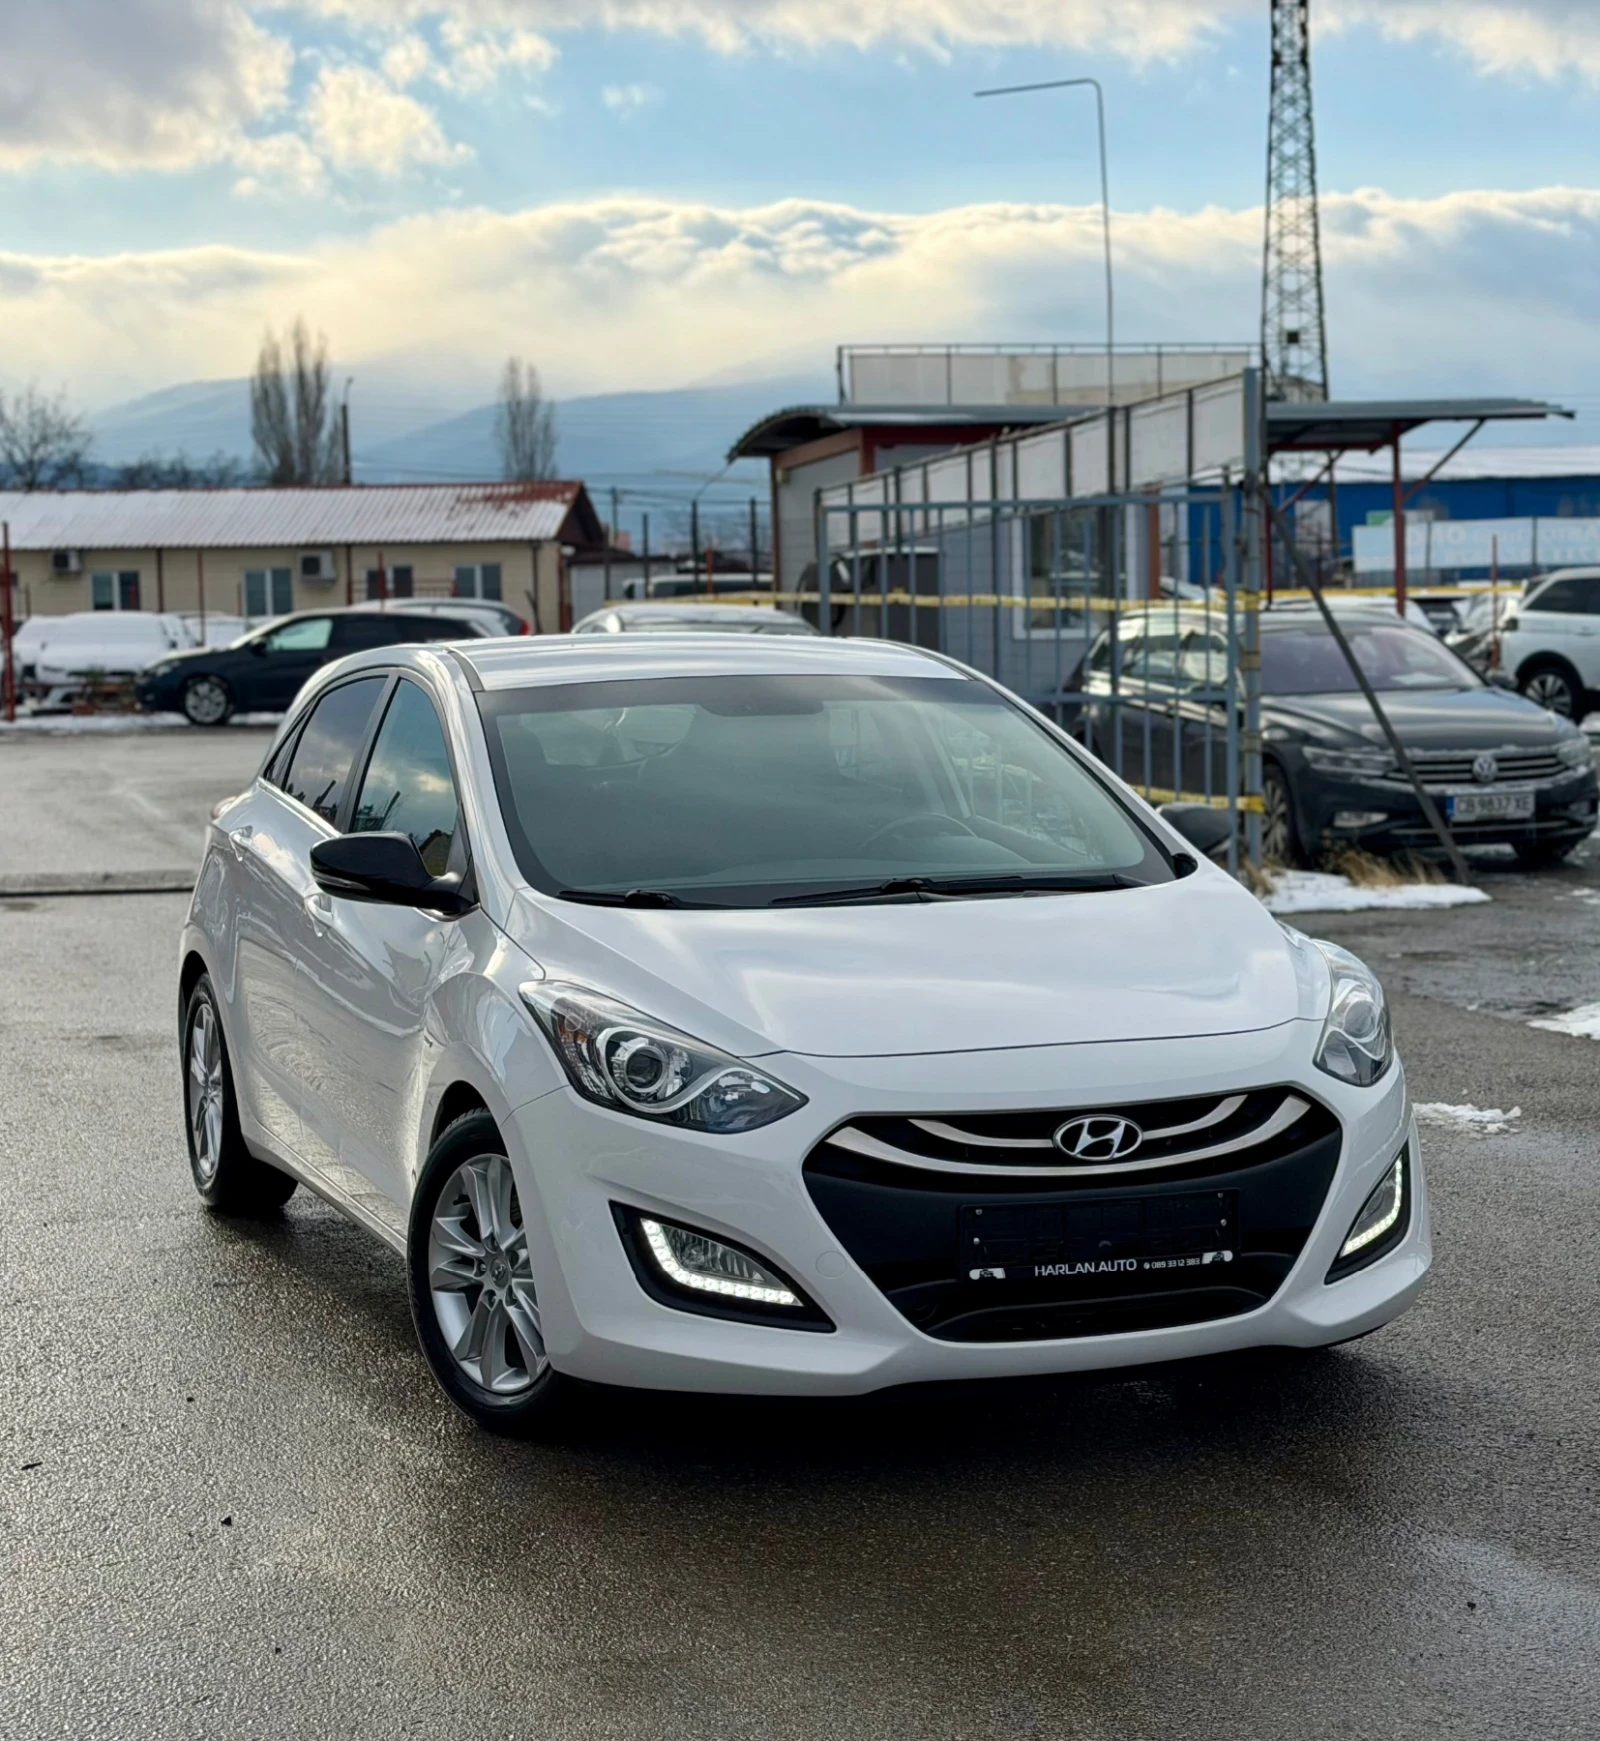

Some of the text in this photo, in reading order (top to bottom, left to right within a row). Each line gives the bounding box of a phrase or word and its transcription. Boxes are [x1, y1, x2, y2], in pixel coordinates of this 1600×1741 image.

[1034, 1258, 1200, 1277] HARLAN.AUTO 089 33 12 383
